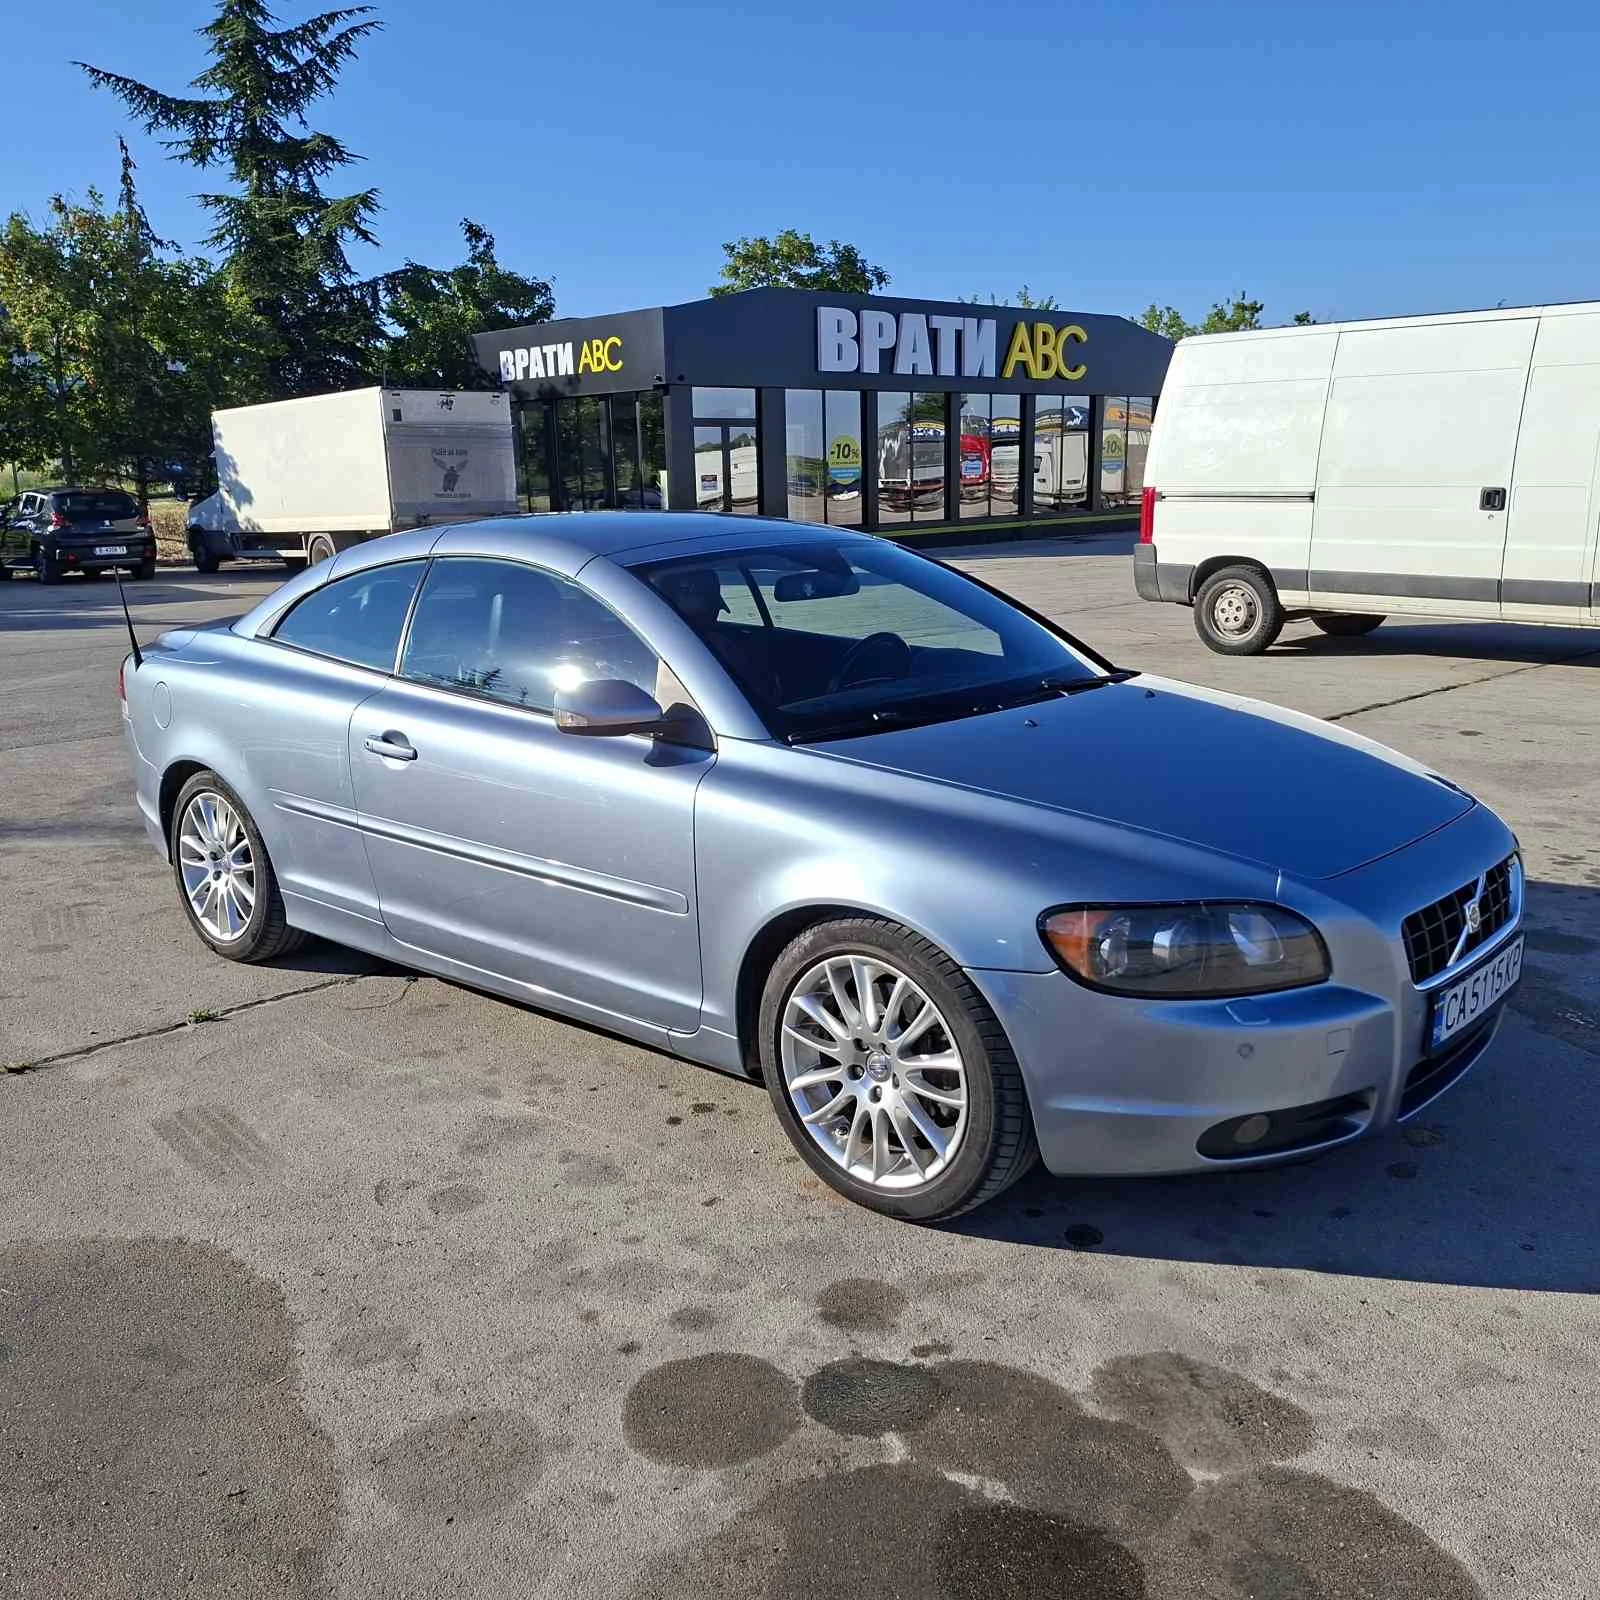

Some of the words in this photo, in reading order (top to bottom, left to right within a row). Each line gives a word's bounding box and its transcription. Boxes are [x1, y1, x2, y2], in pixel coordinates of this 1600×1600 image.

[499, 342, 575, 382] ВРАТИ
[578, 336, 623, 374] ABC
[816, 306, 997, 378] ВРАТИ
[1002, 321, 1088, 381] ABC
[830, 442, 860, 459] -10%
